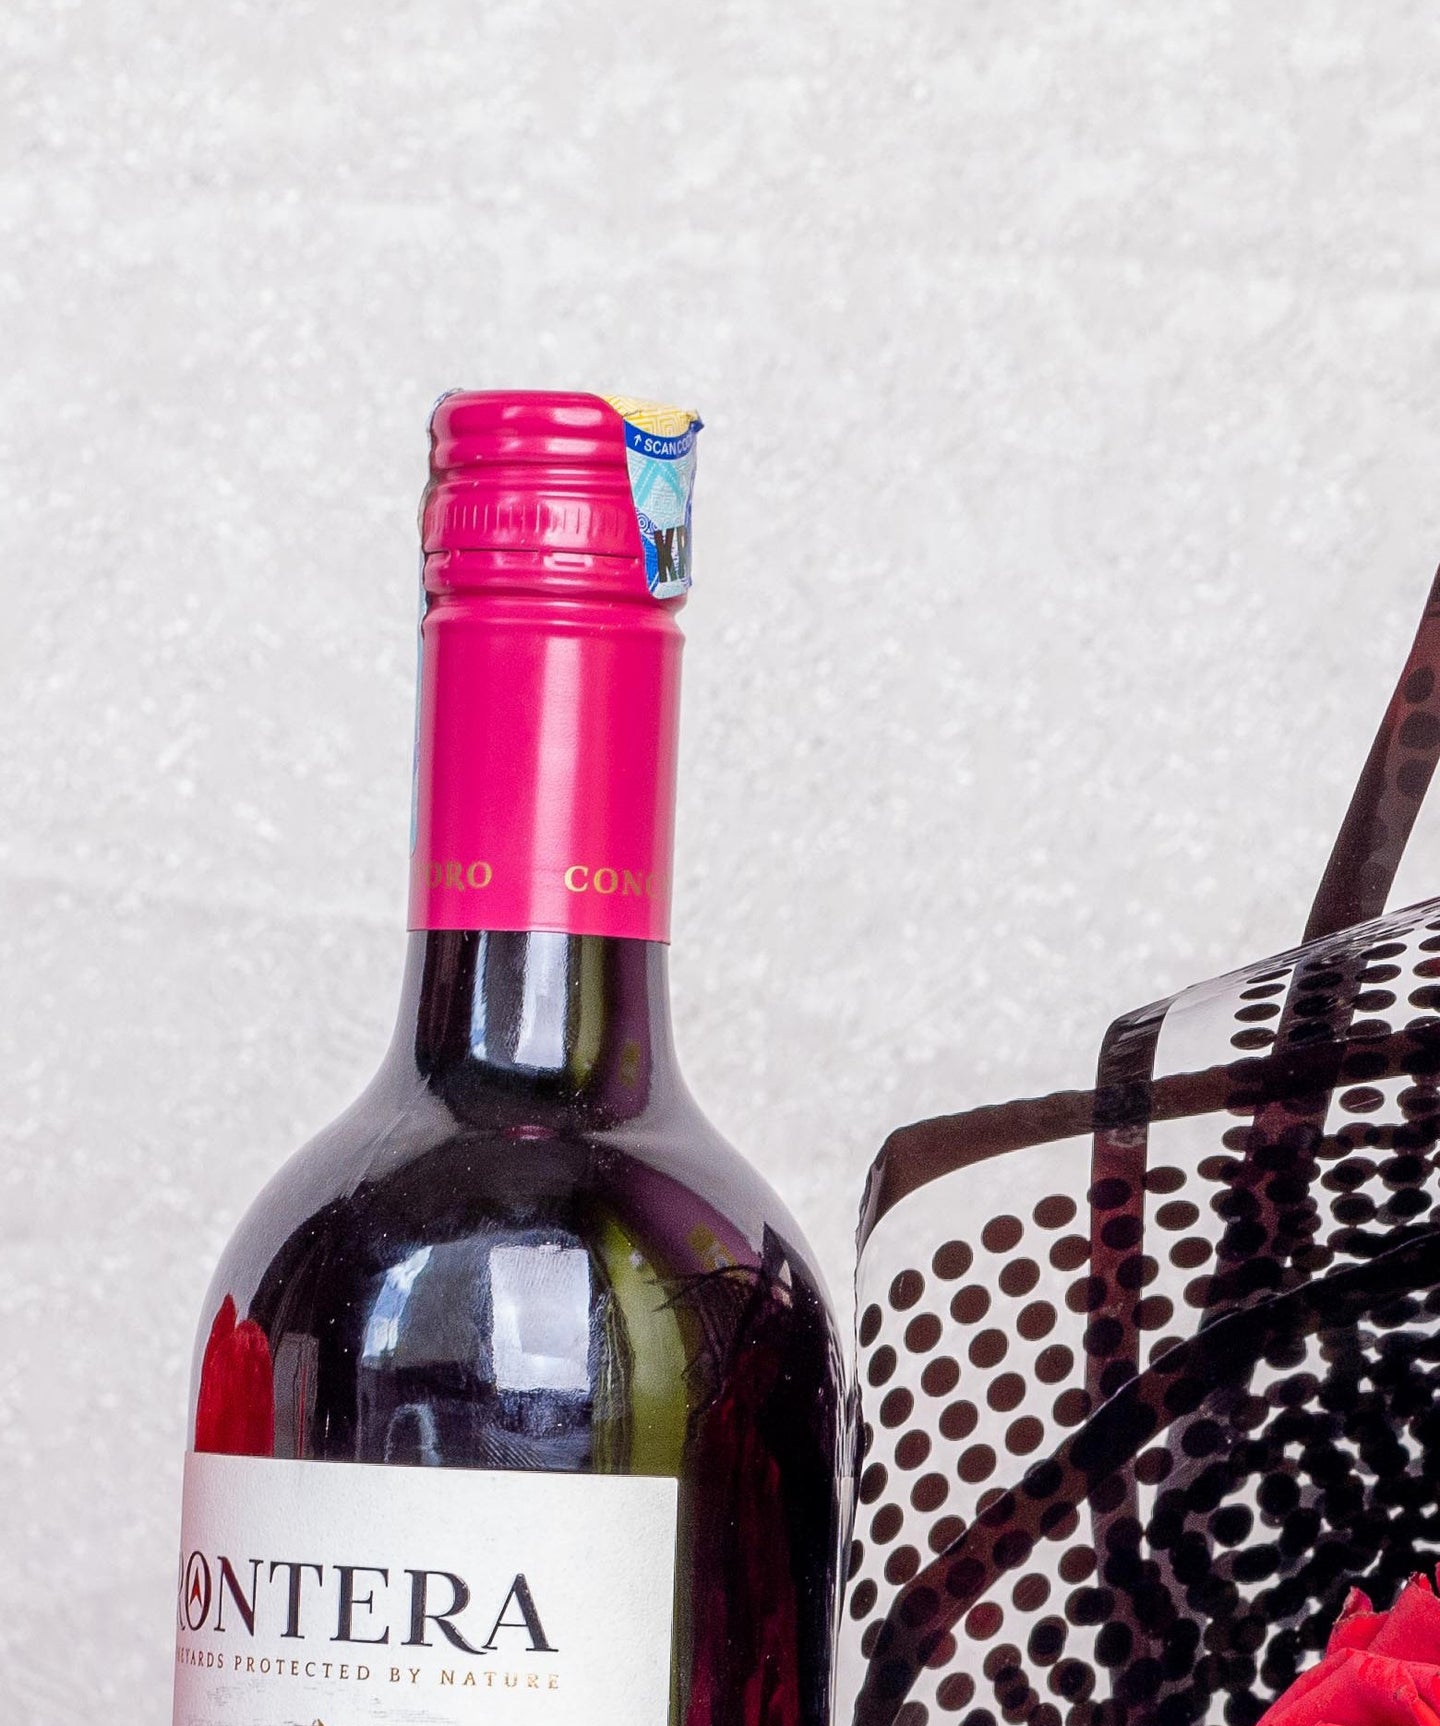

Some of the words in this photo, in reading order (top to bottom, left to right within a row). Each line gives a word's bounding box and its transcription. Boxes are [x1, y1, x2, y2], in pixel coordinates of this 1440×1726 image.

[643, 438, 677, 456] SCAN
[425, 860, 492, 892] ORO
[234, 1655, 371, 1681] PROTECTED
[389, 1666, 421, 1684] BY
[440, 1669, 559, 1690] NATURE
